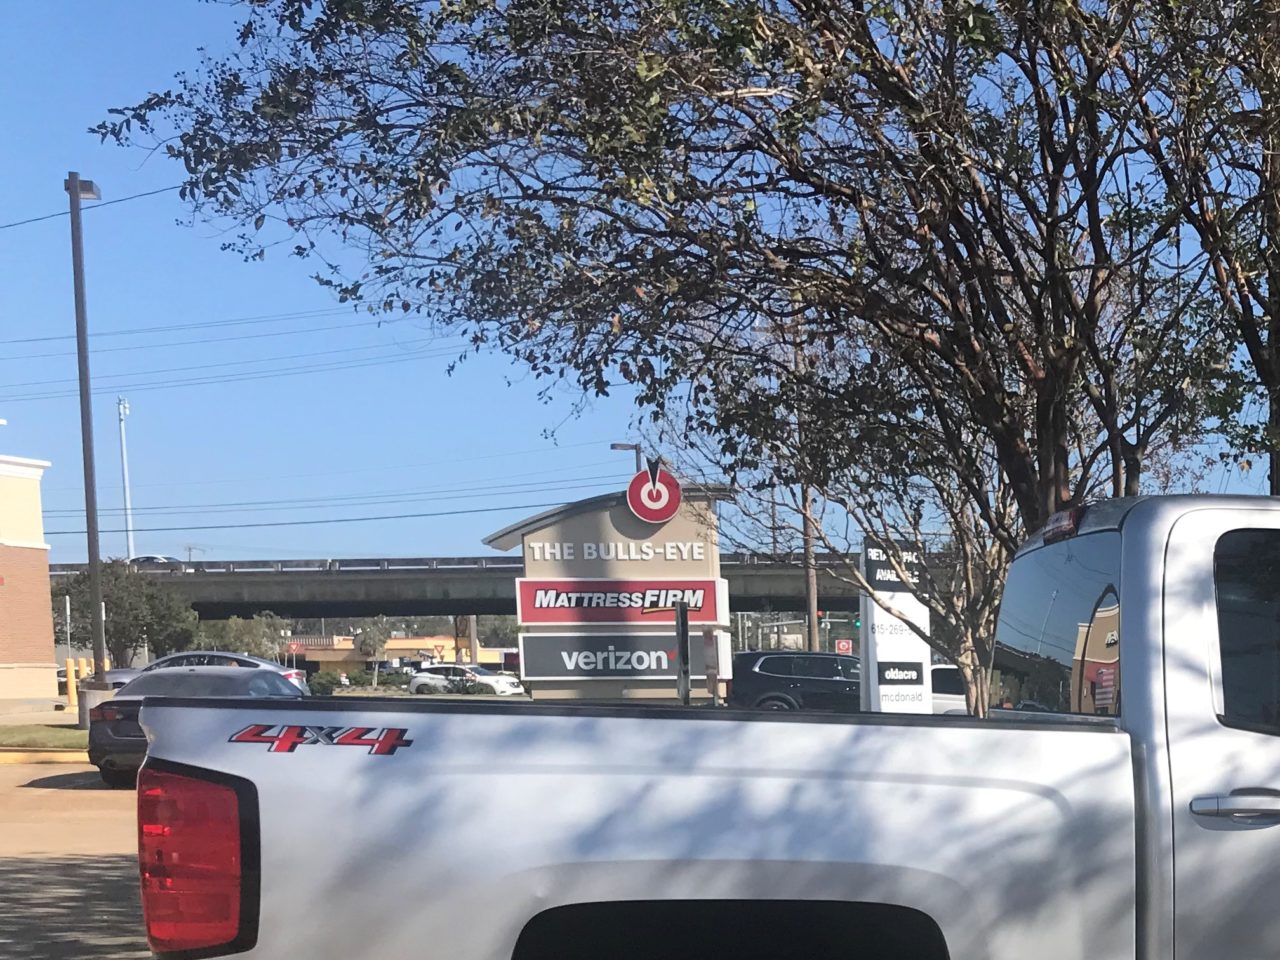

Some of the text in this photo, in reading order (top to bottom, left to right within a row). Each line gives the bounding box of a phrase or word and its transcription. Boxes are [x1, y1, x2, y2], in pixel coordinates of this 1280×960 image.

[529, 542, 705, 561] THE BULLS-EYE
[876, 568, 920, 583] AVAILLE
[561, 645, 669, 670] verizon
[884, 667, 918, 680] oldacre
[881, 691, 923, 703] mcdonald
